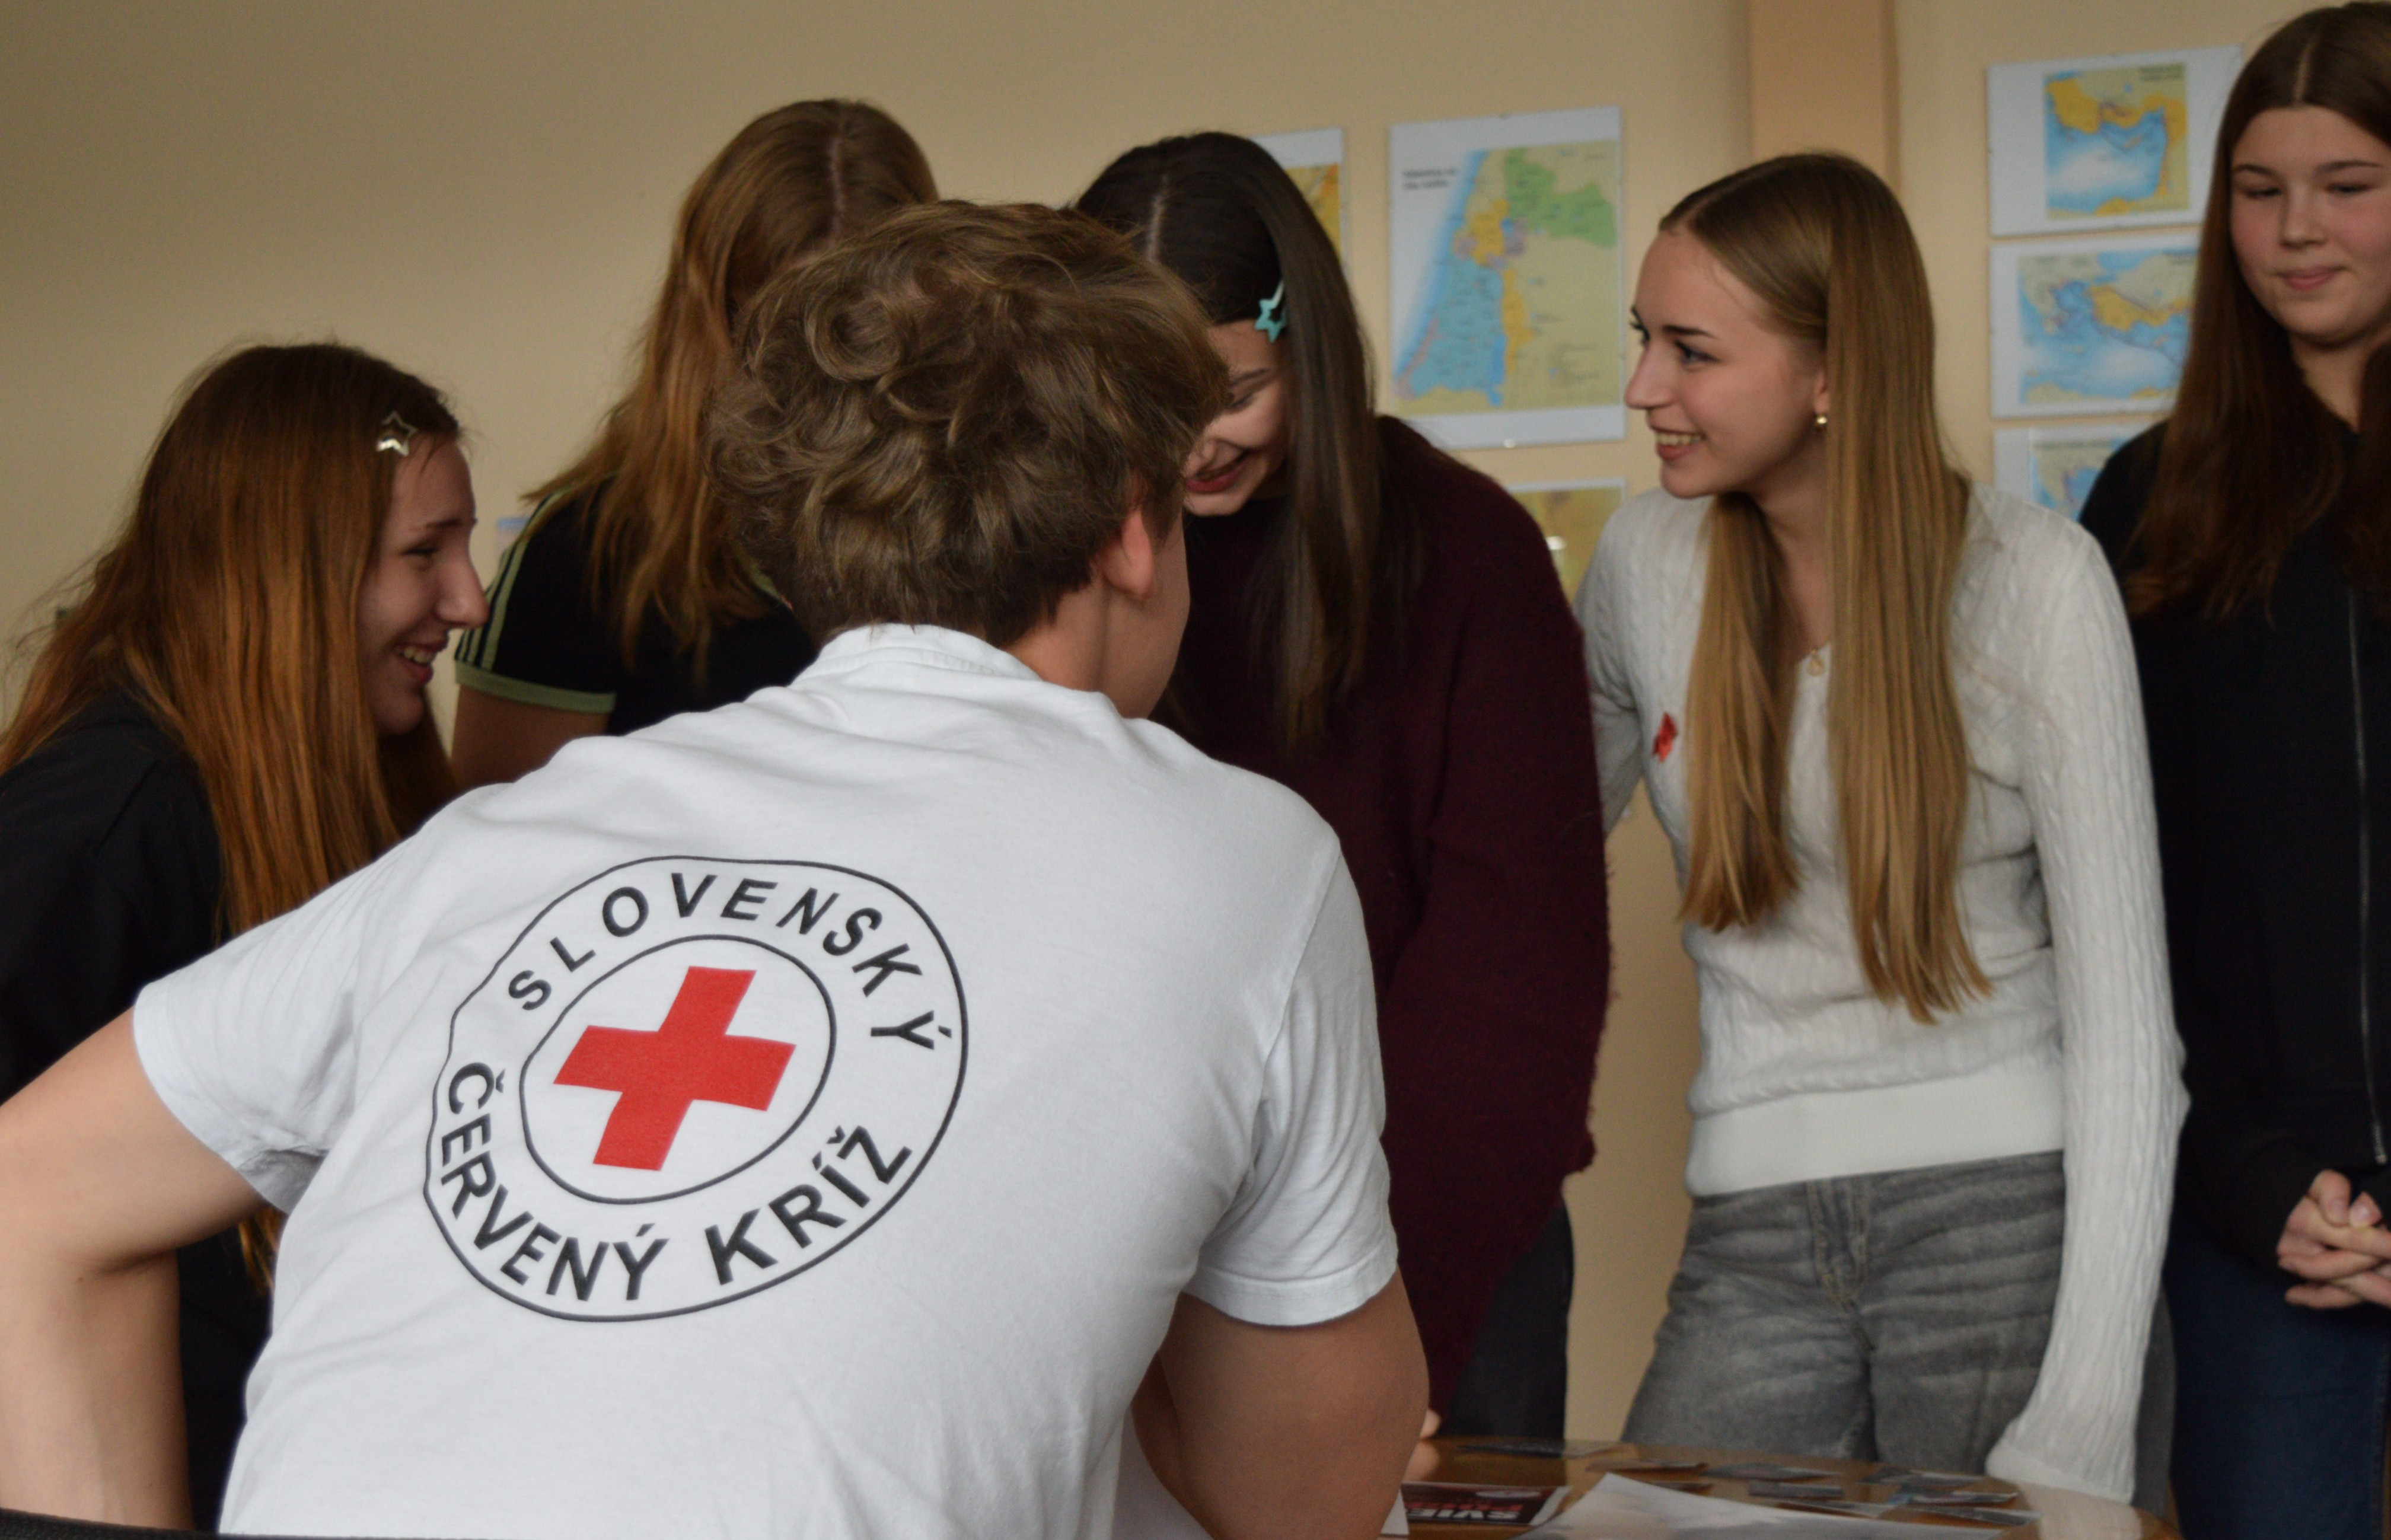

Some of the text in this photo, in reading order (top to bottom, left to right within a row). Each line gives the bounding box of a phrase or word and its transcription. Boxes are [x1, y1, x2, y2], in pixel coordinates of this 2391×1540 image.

[508, 872, 952, 1050] SLOVENSKÝ
[440, 1061, 912, 1302] ČERVENÝ KRÍŽ
